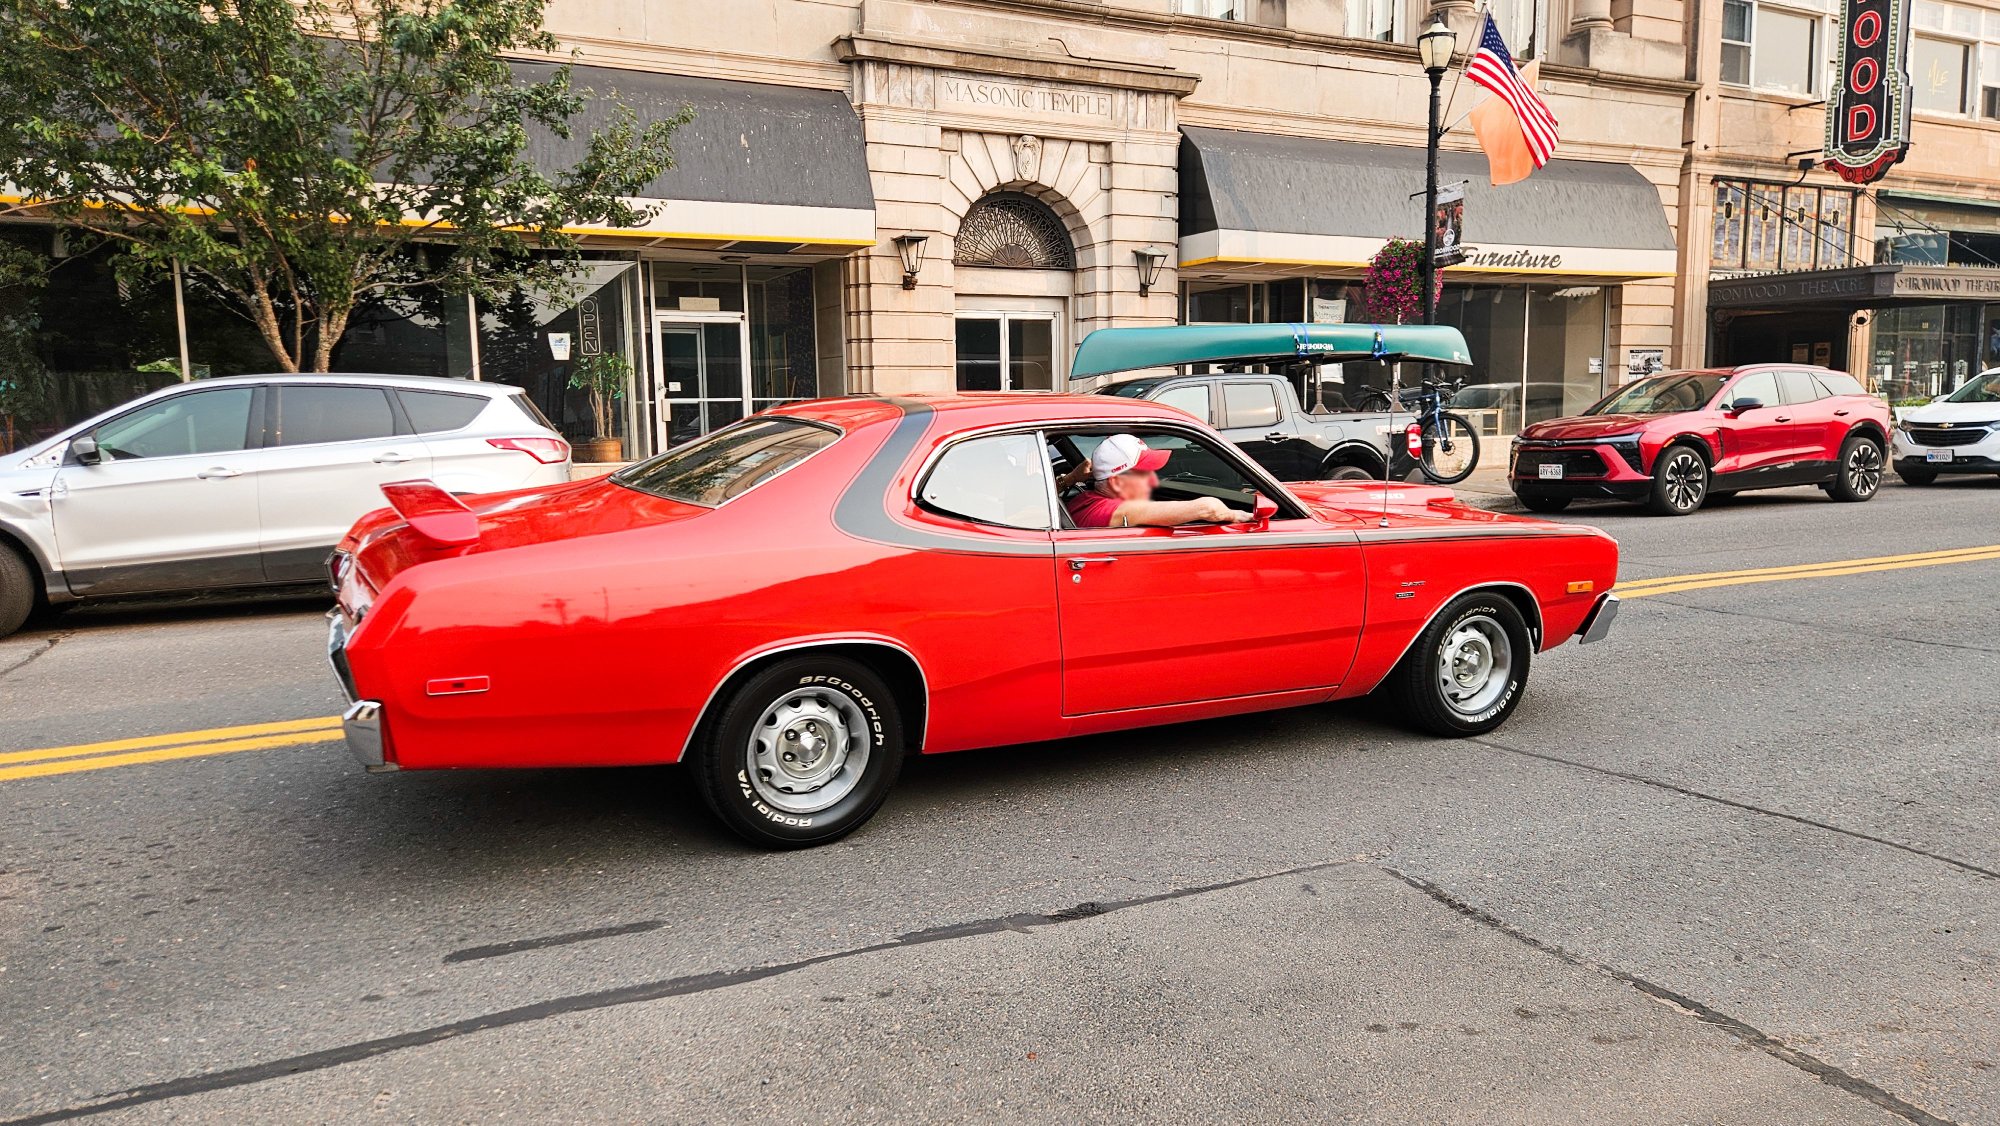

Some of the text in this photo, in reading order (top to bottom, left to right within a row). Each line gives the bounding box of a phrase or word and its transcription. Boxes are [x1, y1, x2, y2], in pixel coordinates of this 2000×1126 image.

[1847, 0, 1882, 142] OOD
[945, 81, 1107, 116] MASONIC TEMPLE
[1457, 246, 1562, 269] Furniture
[1710, 284, 1786, 303] IRONWOOD
[1799, 276, 1867, 296] THEATRE
[1908, 276, 1960, 292] IRONWOOD
[581, 300, 597, 352] OPEN
[799, 675, 885, 746] BFGoodrich
[1486, 680, 1518, 719] Radial
[737, 769, 813, 828] Radial T/A
